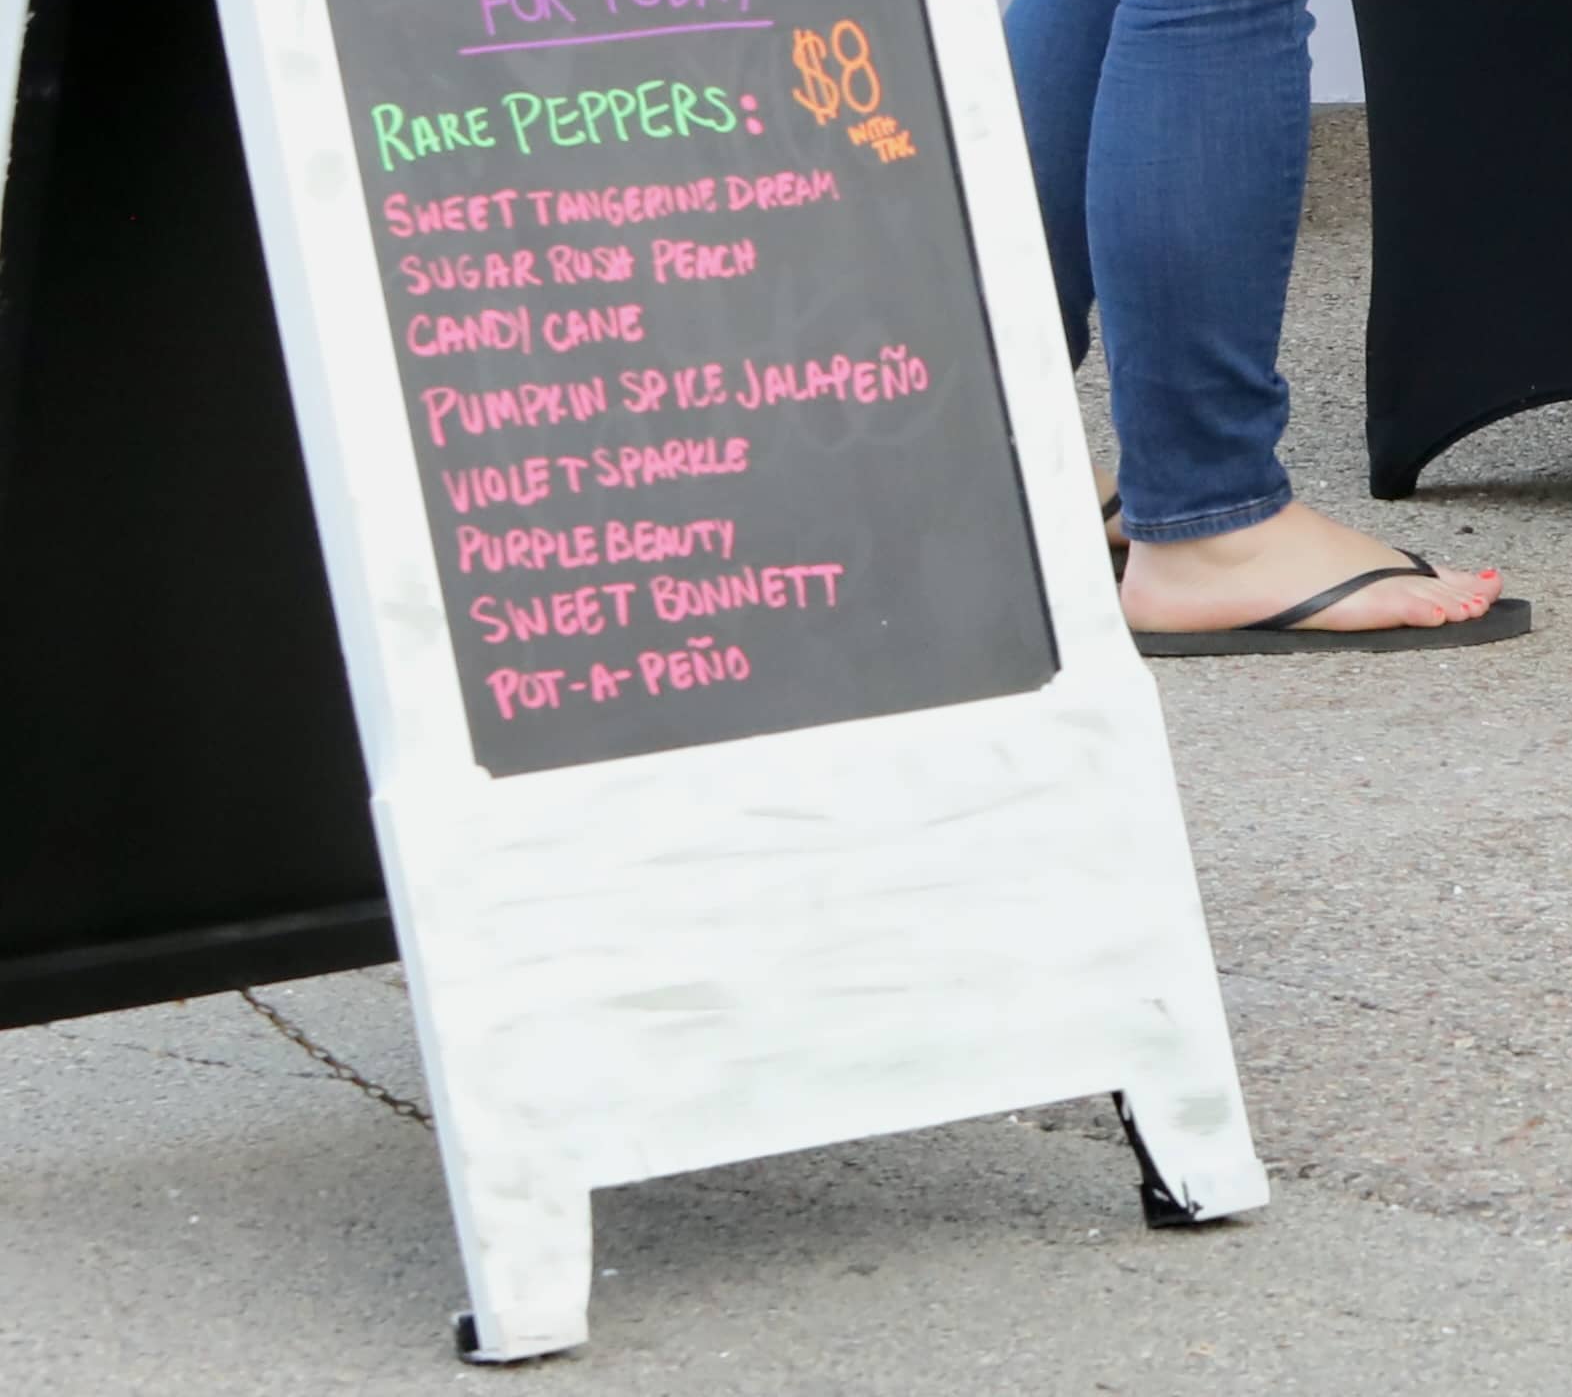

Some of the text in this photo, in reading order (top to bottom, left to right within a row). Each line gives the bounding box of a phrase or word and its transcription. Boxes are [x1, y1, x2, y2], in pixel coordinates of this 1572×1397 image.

[791, 18, 886, 127] $8
[371, 103, 495, 171] RARE
[384, 169, 841, 238] SWEET TANGERINE DREAM
[401, 239, 757, 295] SUGAR RUSH PEACH
[406, 304, 645, 358] CANDY CANE
[420, 344, 930, 447] PUMPKIN SPICE JALAPEÑO
[441, 438, 750, 513] VIOLET SPARKLE
[456, 519, 736, 574] PURPLE BEAUTY
[470, 564, 845, 644] SWEET BONNETT
